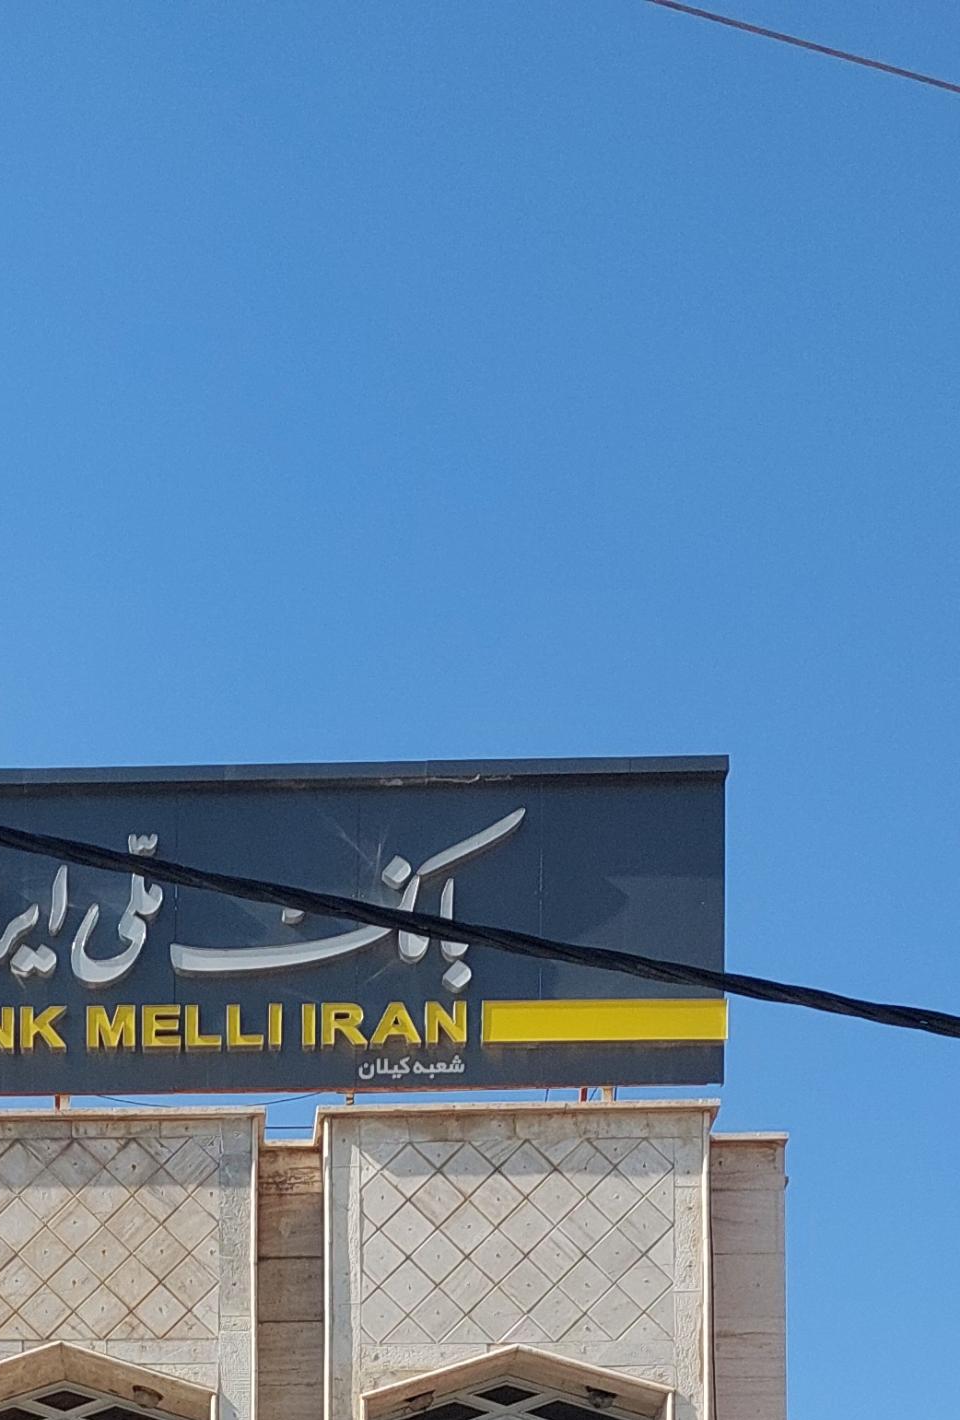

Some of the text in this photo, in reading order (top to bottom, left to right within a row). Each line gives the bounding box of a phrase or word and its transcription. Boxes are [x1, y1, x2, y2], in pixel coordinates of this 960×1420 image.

[170, 808, 526, 992] بانک
[87, 1004, 282, 1050] MELLI
[302, 1001, 468, 1047] IRAN
[412, 1055, 466, 1075] شعبه
